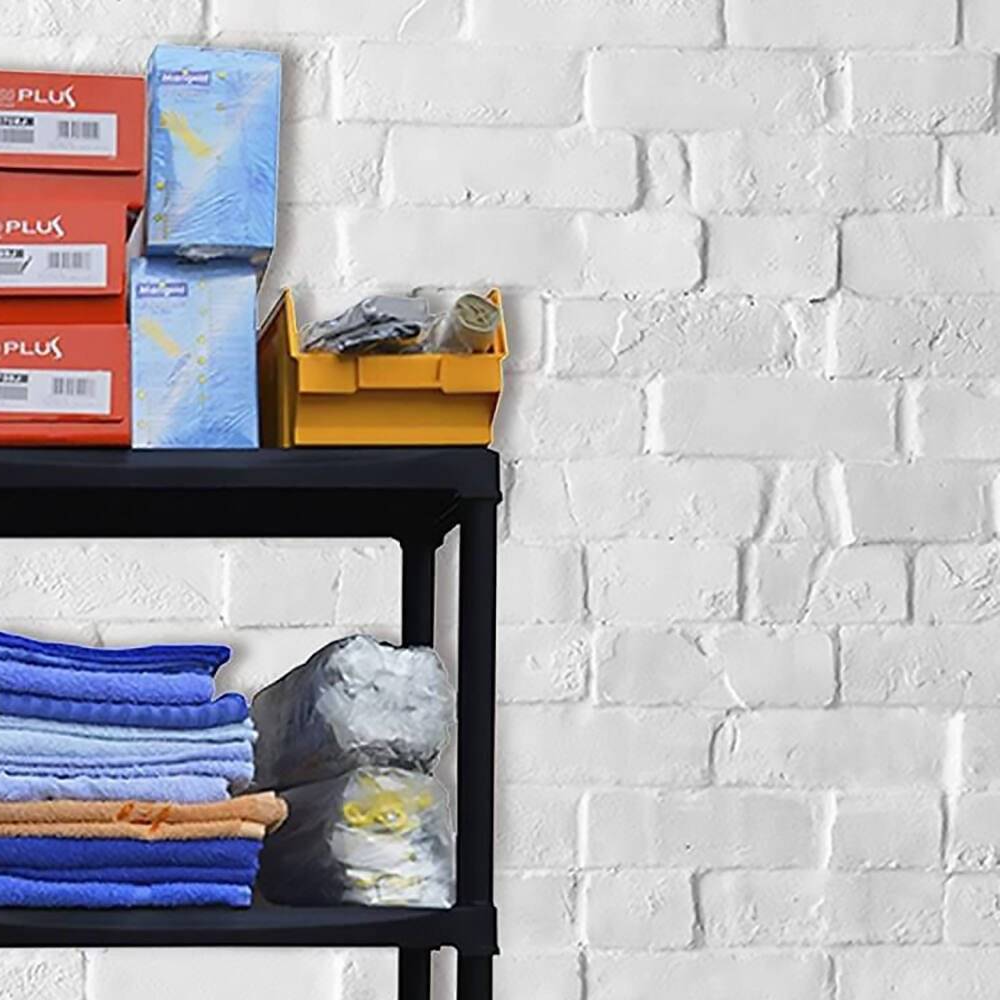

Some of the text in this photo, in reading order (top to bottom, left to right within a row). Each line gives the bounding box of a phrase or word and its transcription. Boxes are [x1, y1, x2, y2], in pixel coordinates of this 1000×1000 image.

[17, 85, 77, 109] PLUS
[5, 214, 65, 238] PLUS
[3, 335, 63, 360] PLUS
